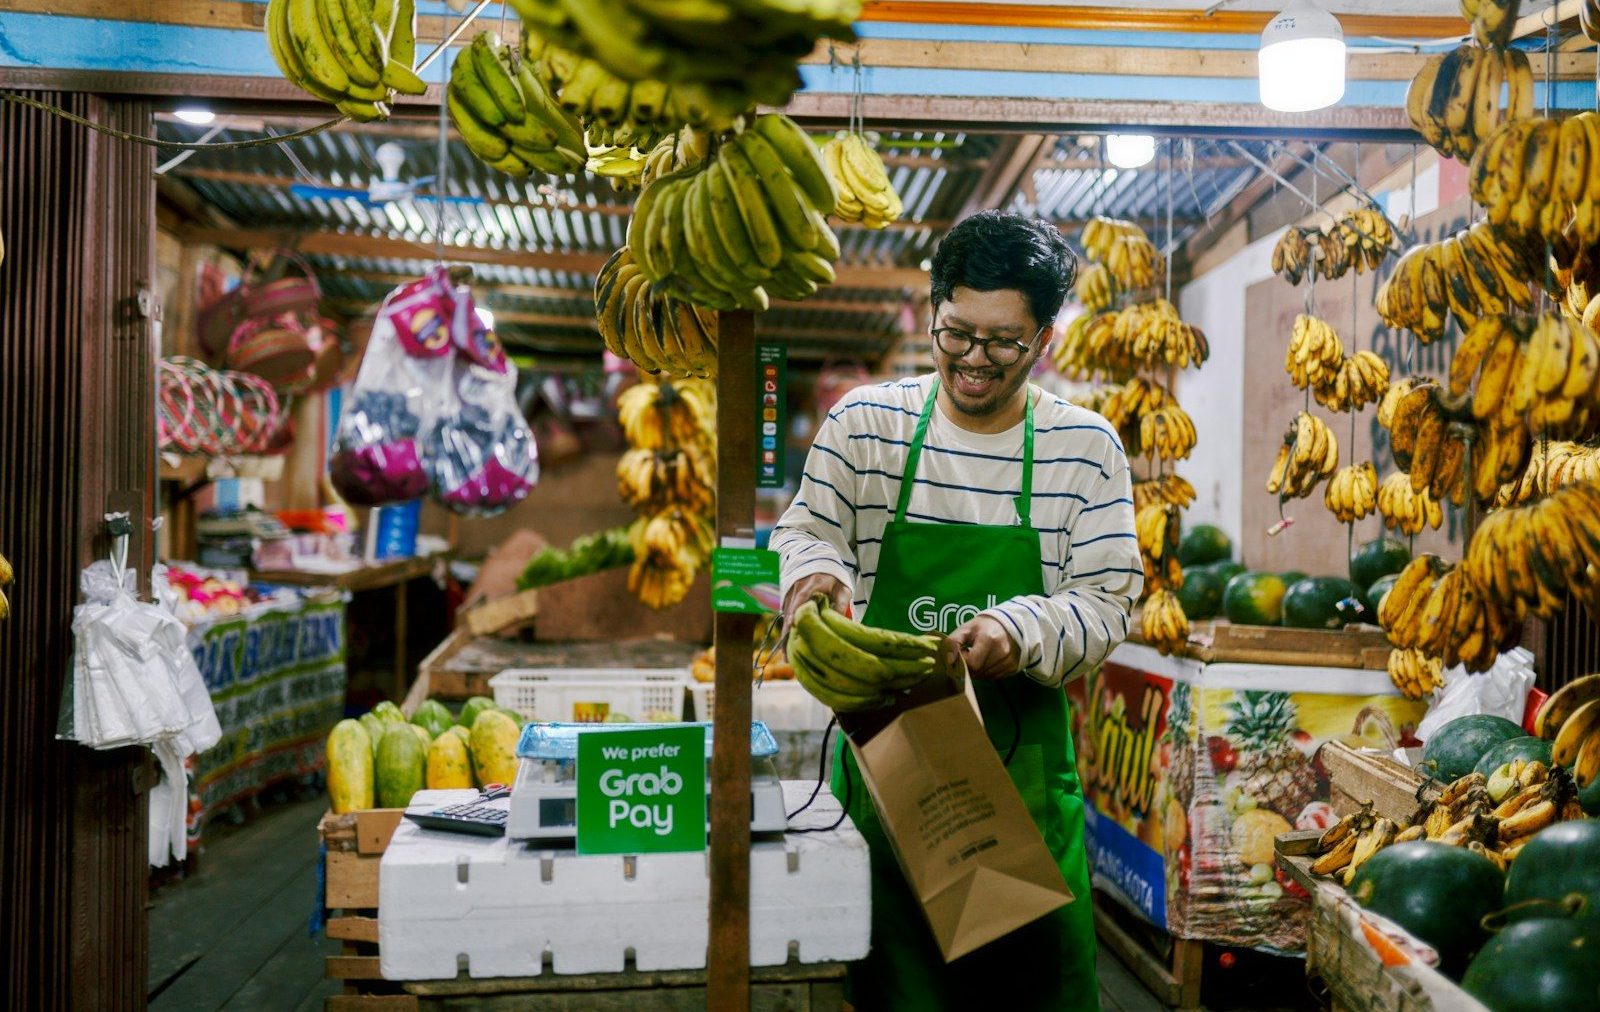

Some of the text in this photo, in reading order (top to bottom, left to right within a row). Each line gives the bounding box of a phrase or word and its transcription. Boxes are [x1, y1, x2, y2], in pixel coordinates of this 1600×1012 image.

[602, 743, 681, 762] We prefer
[599, 765, 683, 797] Grab
[609, 800, 673, 836] Pay
